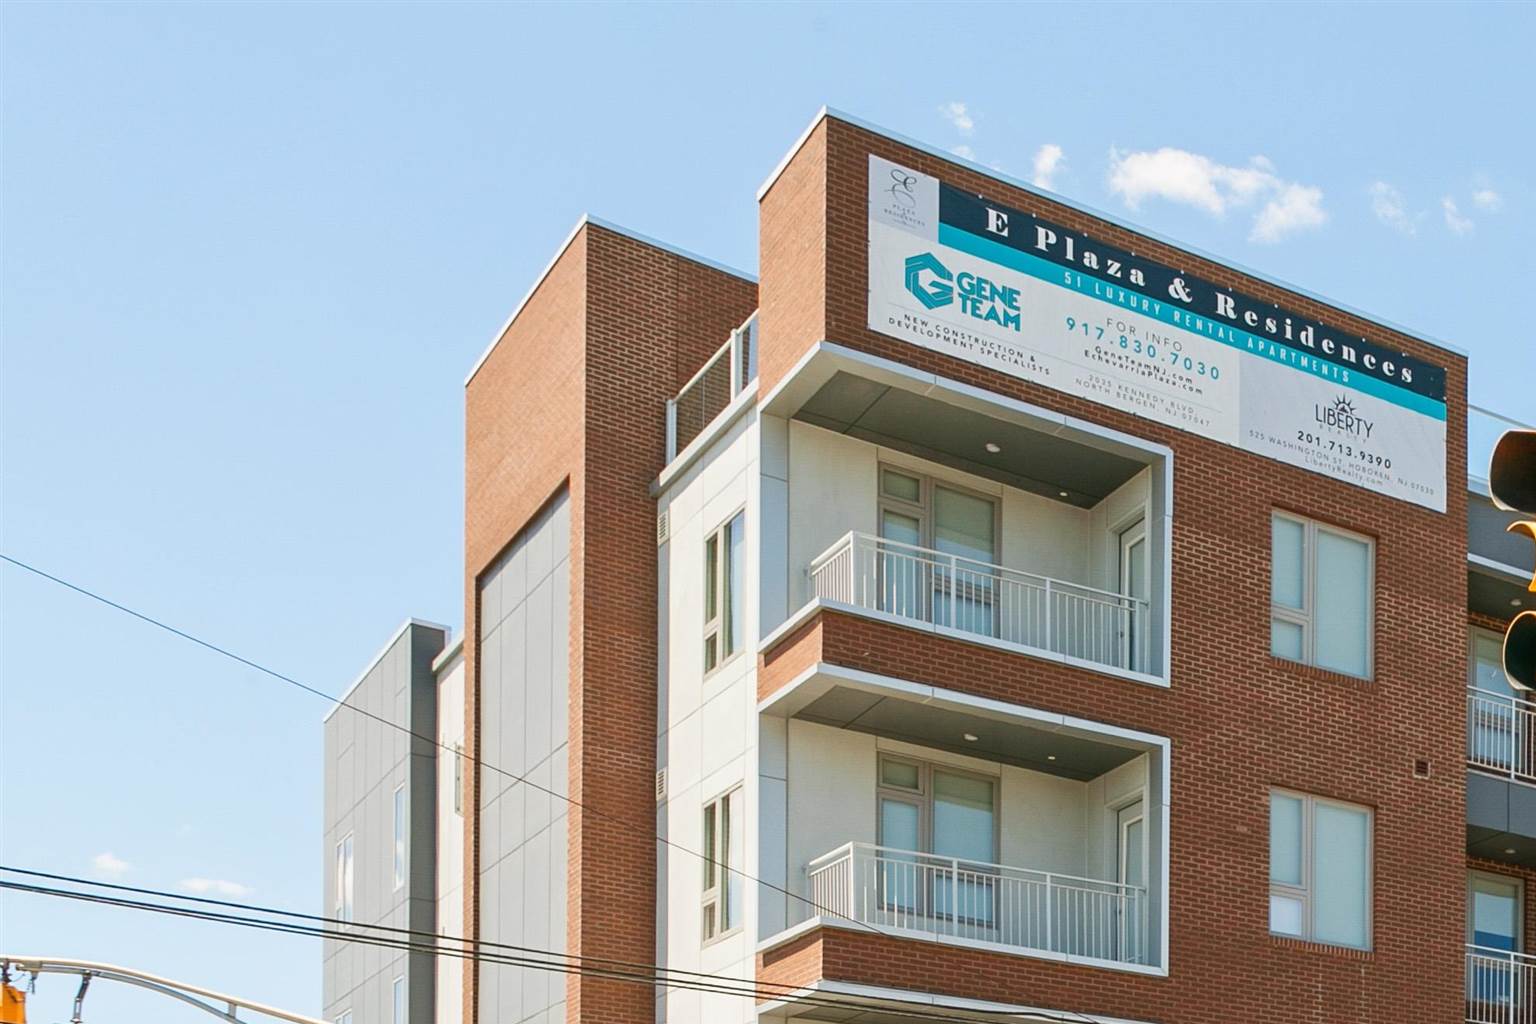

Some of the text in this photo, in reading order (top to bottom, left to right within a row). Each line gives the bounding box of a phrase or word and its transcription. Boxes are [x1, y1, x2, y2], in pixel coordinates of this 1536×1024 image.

[957, 272, 1021, 311] GENE
[985, 207, 1413, 383] E Plaza & Residences
[958, 293, 1021, 332] TEAM
[888, 317, 1050, 375] DEVELOPMENT SPECIALISTS
[904, 314, 1036, 363] NEW CONSTRUCTION &
[1066, 317, 1220, 380] 917.830.7030
[1095, 283, 1160, 315] LUXURY
[1173, 310, 1235, 343] RENTAL
[1247, 337, 1349, 382] APARTMENTS
[1106, 318, 1183, 352] FOR INFO
[1084, 349, 1203, 395] EchevarriaPlaza.com
[1094, 346, 1193, 384] GeneTeamNJ.com
[1075, 378, 1110, 395] NORTH
[1118, 384, 1165, 405] KENNEDY
[1315, 404, 1374, 438] LIBERTY
[1269, 436, 1329, 462] WASHINGTON
[1297, 430, 1392, 470] 201.713.9390
